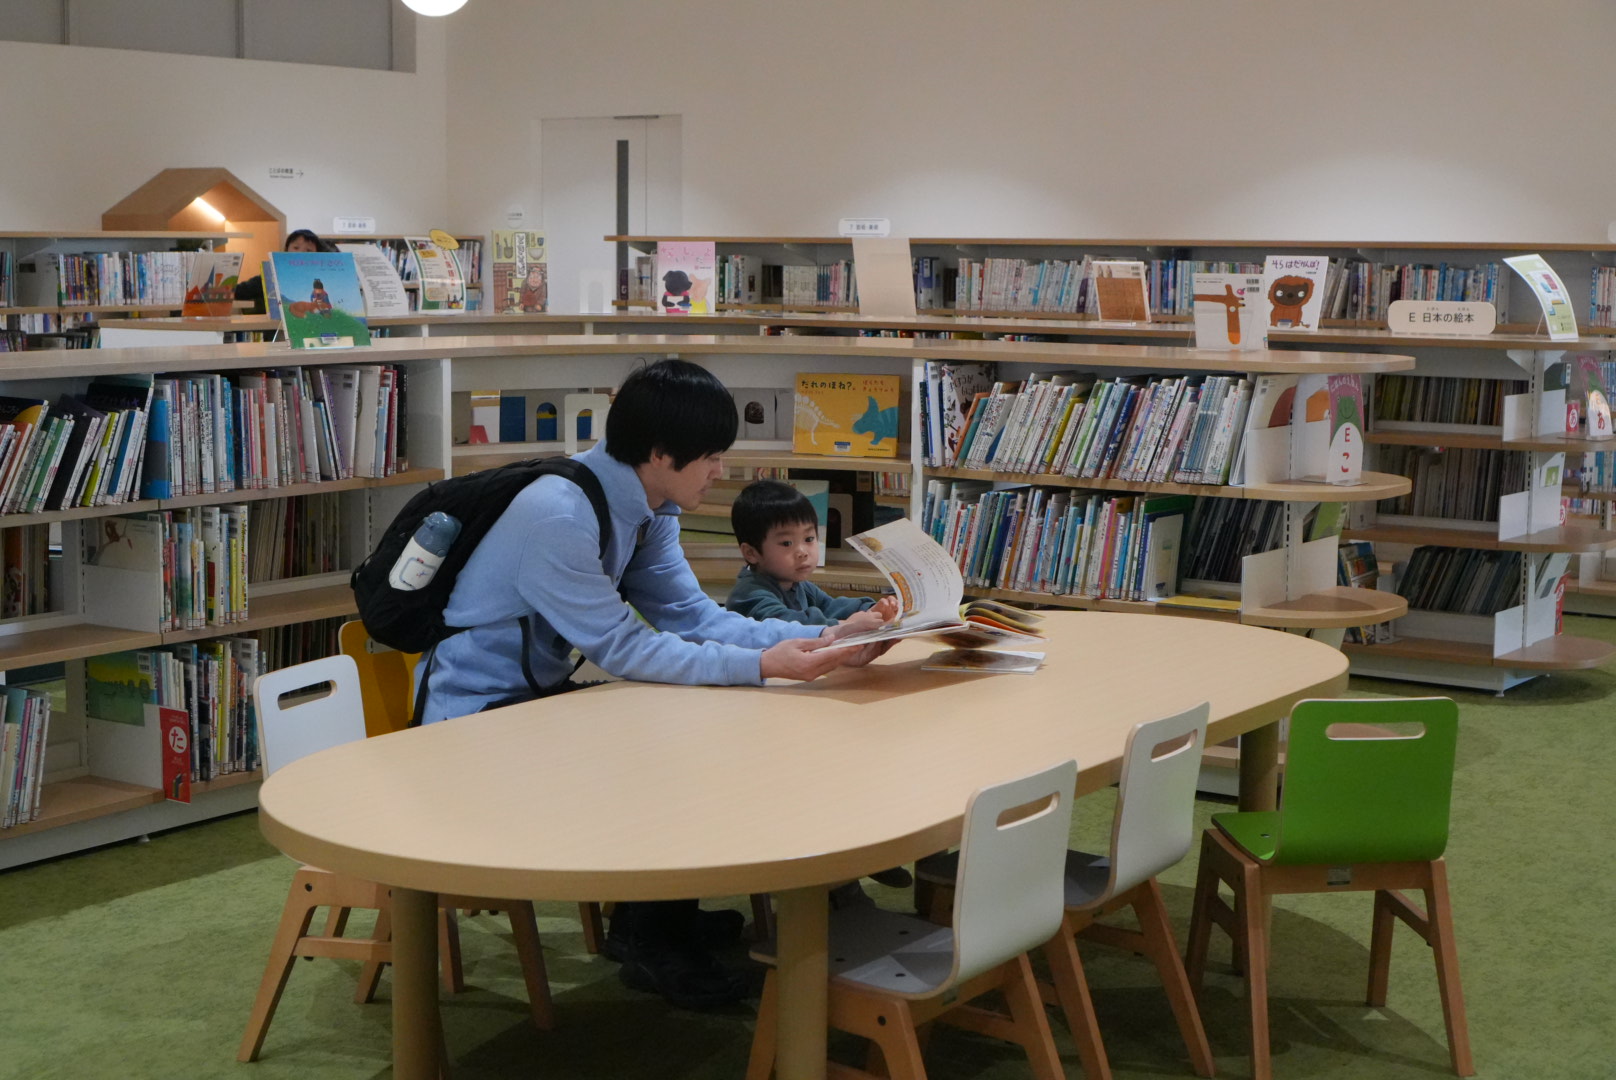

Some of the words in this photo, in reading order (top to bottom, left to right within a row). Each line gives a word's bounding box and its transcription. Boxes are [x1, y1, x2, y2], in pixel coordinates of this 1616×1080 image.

[1409, 312, 1416, 322] E
[1422, 312, 1474, 323] 日本の絵本
[1597, 411, 1605, 430] あ
[1344, 427, 1351, 443] E
[1341, 452, 1350, 473] こ
[171, 728, 184, 751] た
